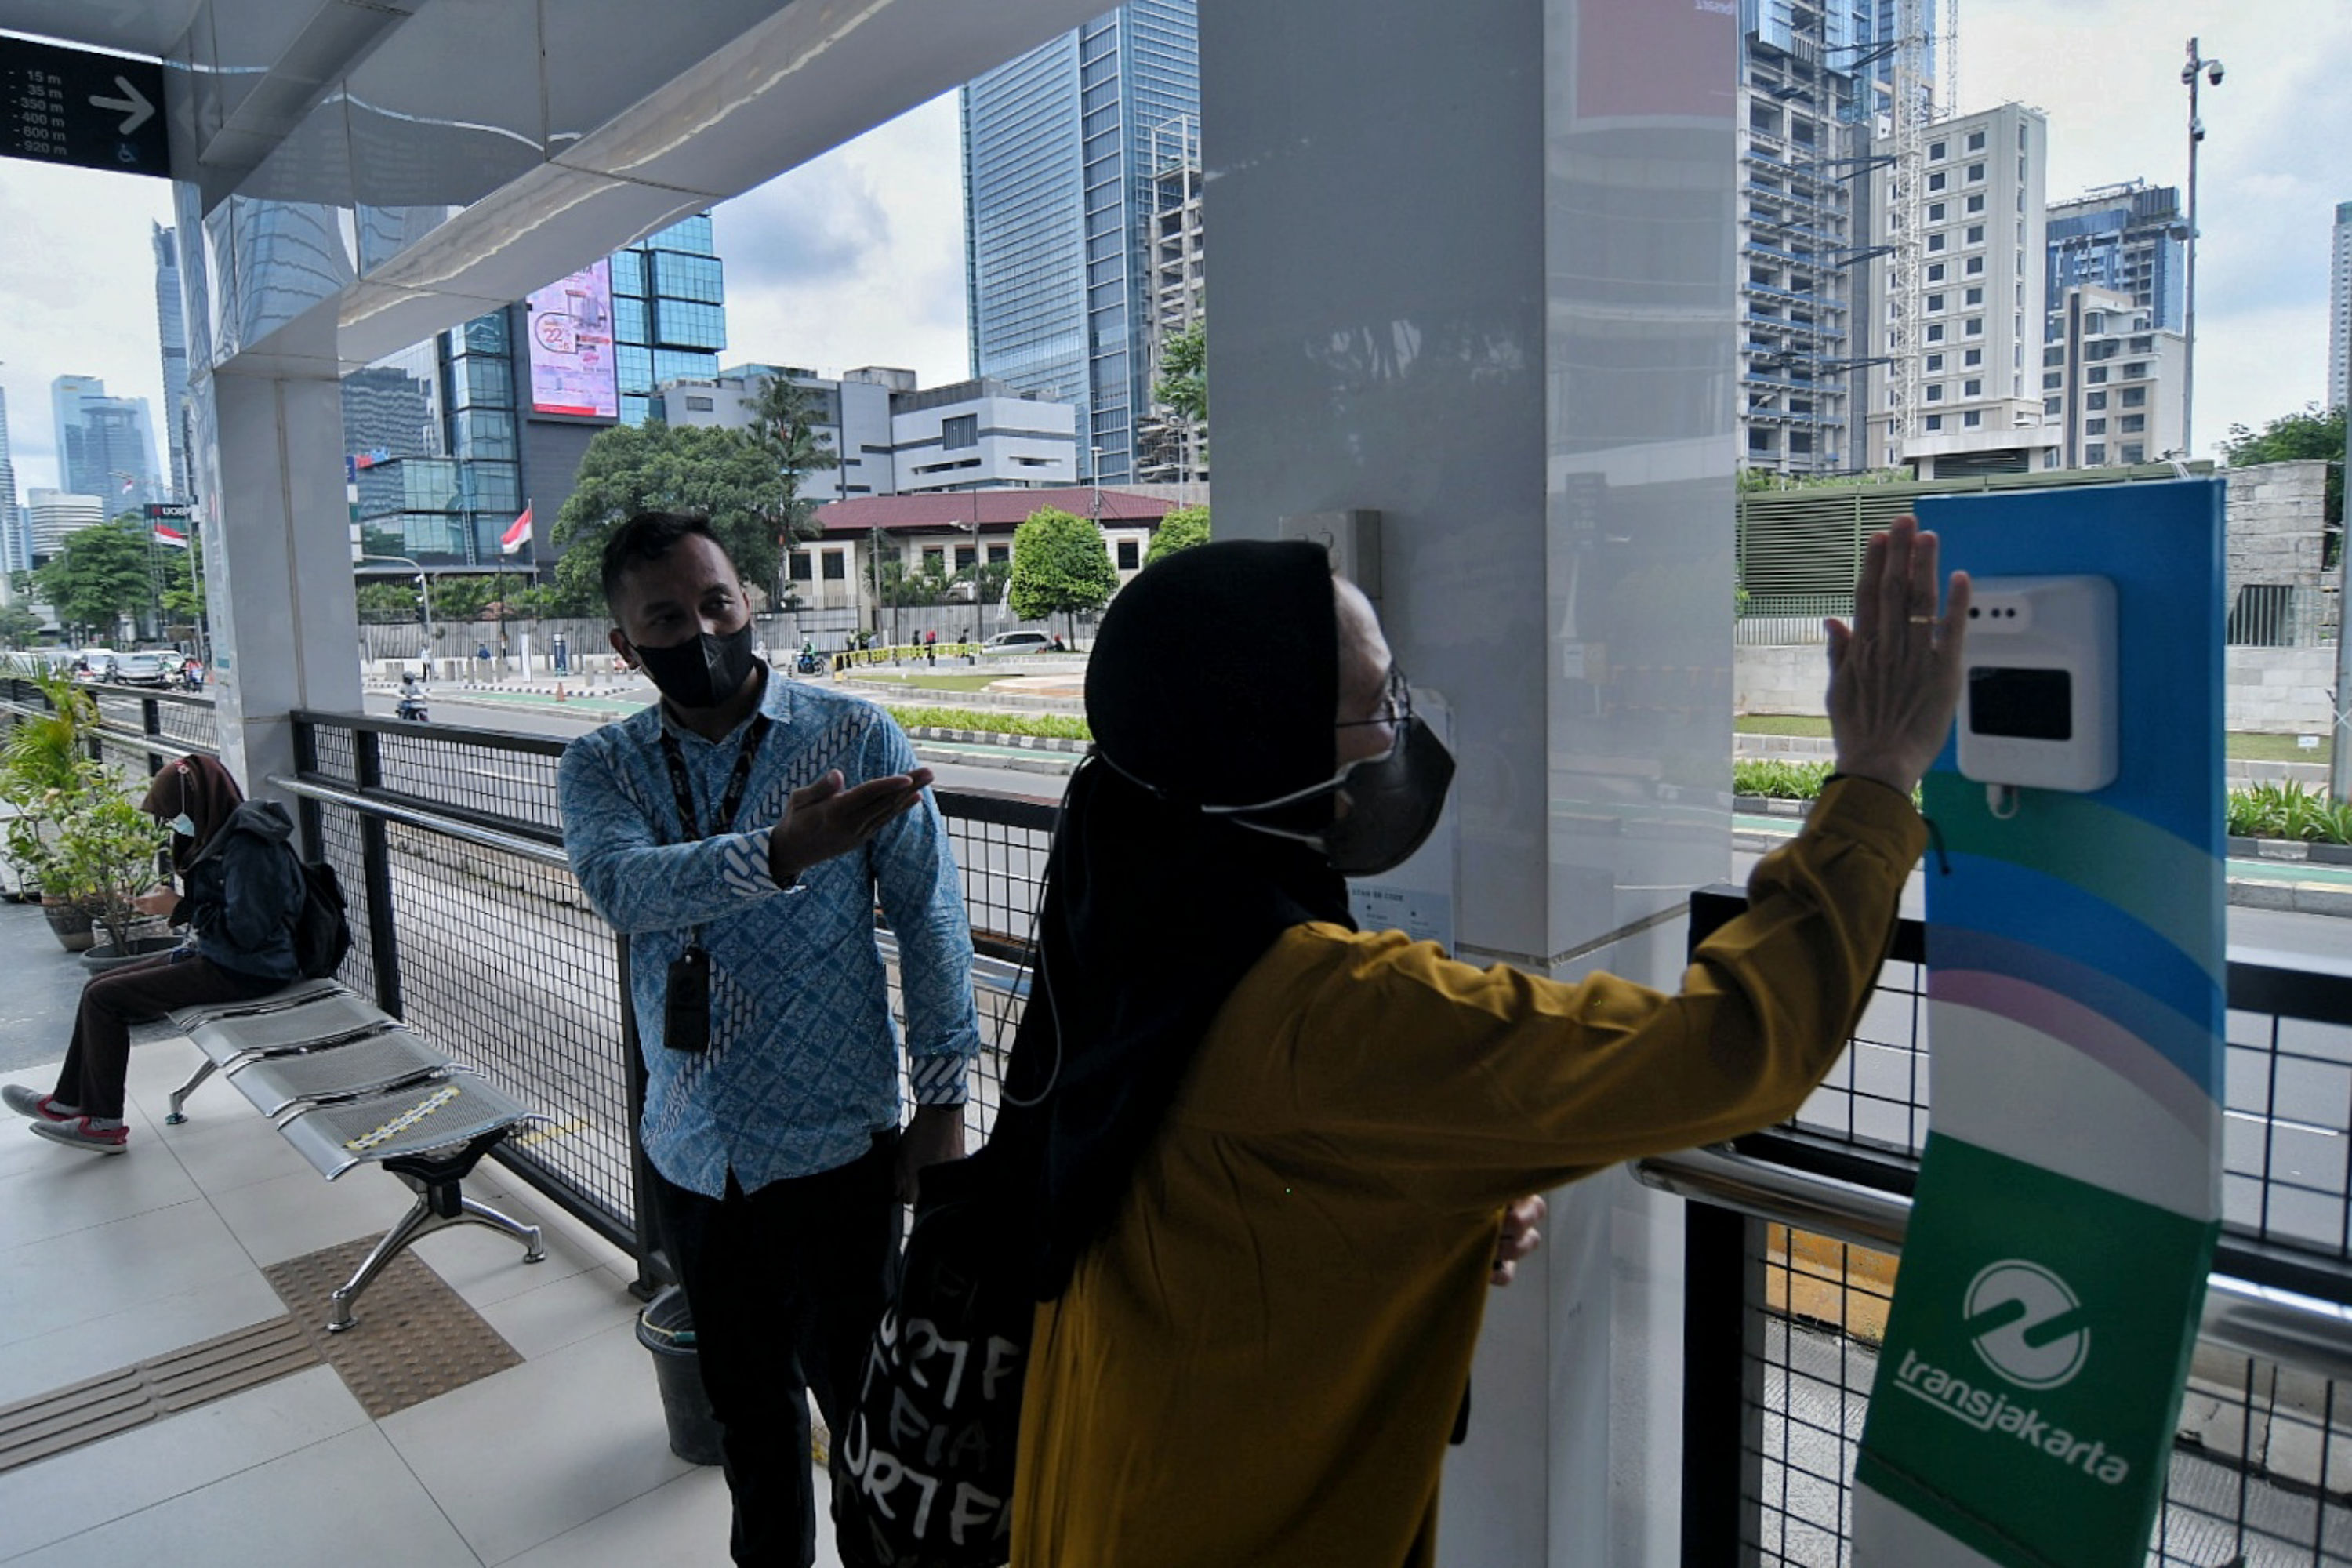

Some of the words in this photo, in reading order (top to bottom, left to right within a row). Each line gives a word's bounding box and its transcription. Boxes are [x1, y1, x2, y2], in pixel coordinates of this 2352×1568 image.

[27, 70, 44, 82] 15
[47, 74, 62, 85] m
[27, 84, 45, 96] 35
[49, 89, 63, 99] m
[20, 97, 46, 111] 350
[49, 103, 64, 114] m
[21, 111, 47, 125] 400
[51, 118, 65, 128] m
[53, 132, 66, 142] m
[24, 140, 50, 154] 920
[53, 145, 67, 156] m
[1893, 1348, 2129, 1484] transjakarta
